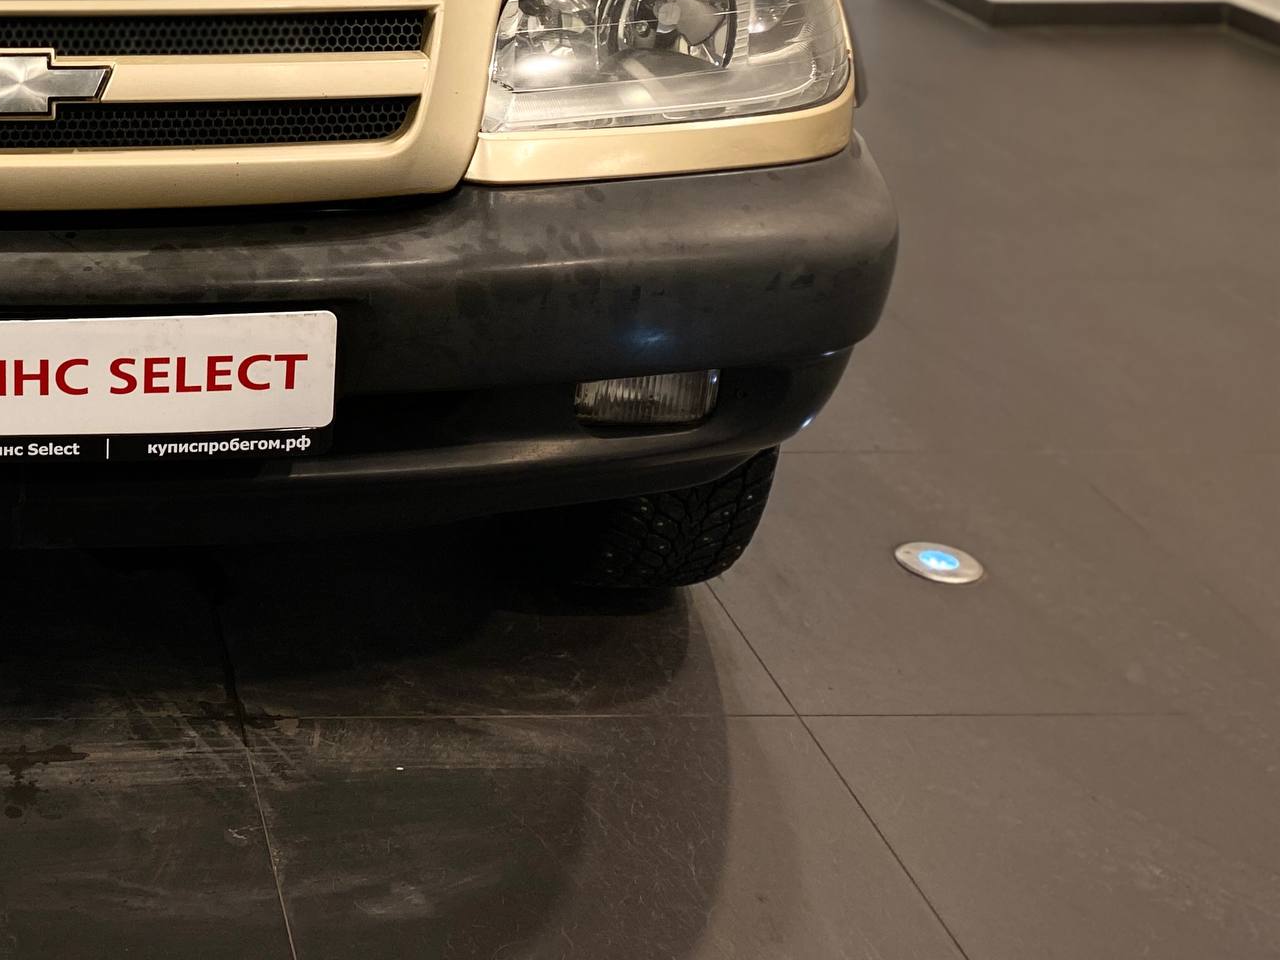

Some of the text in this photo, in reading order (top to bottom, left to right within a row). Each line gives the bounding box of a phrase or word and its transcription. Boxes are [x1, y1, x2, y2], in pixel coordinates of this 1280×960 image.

[109, 354, 308, 395] SELECT
[27, 442, 80, 456] Select
[147, 435, 312, 457] куписпробегом.рф
